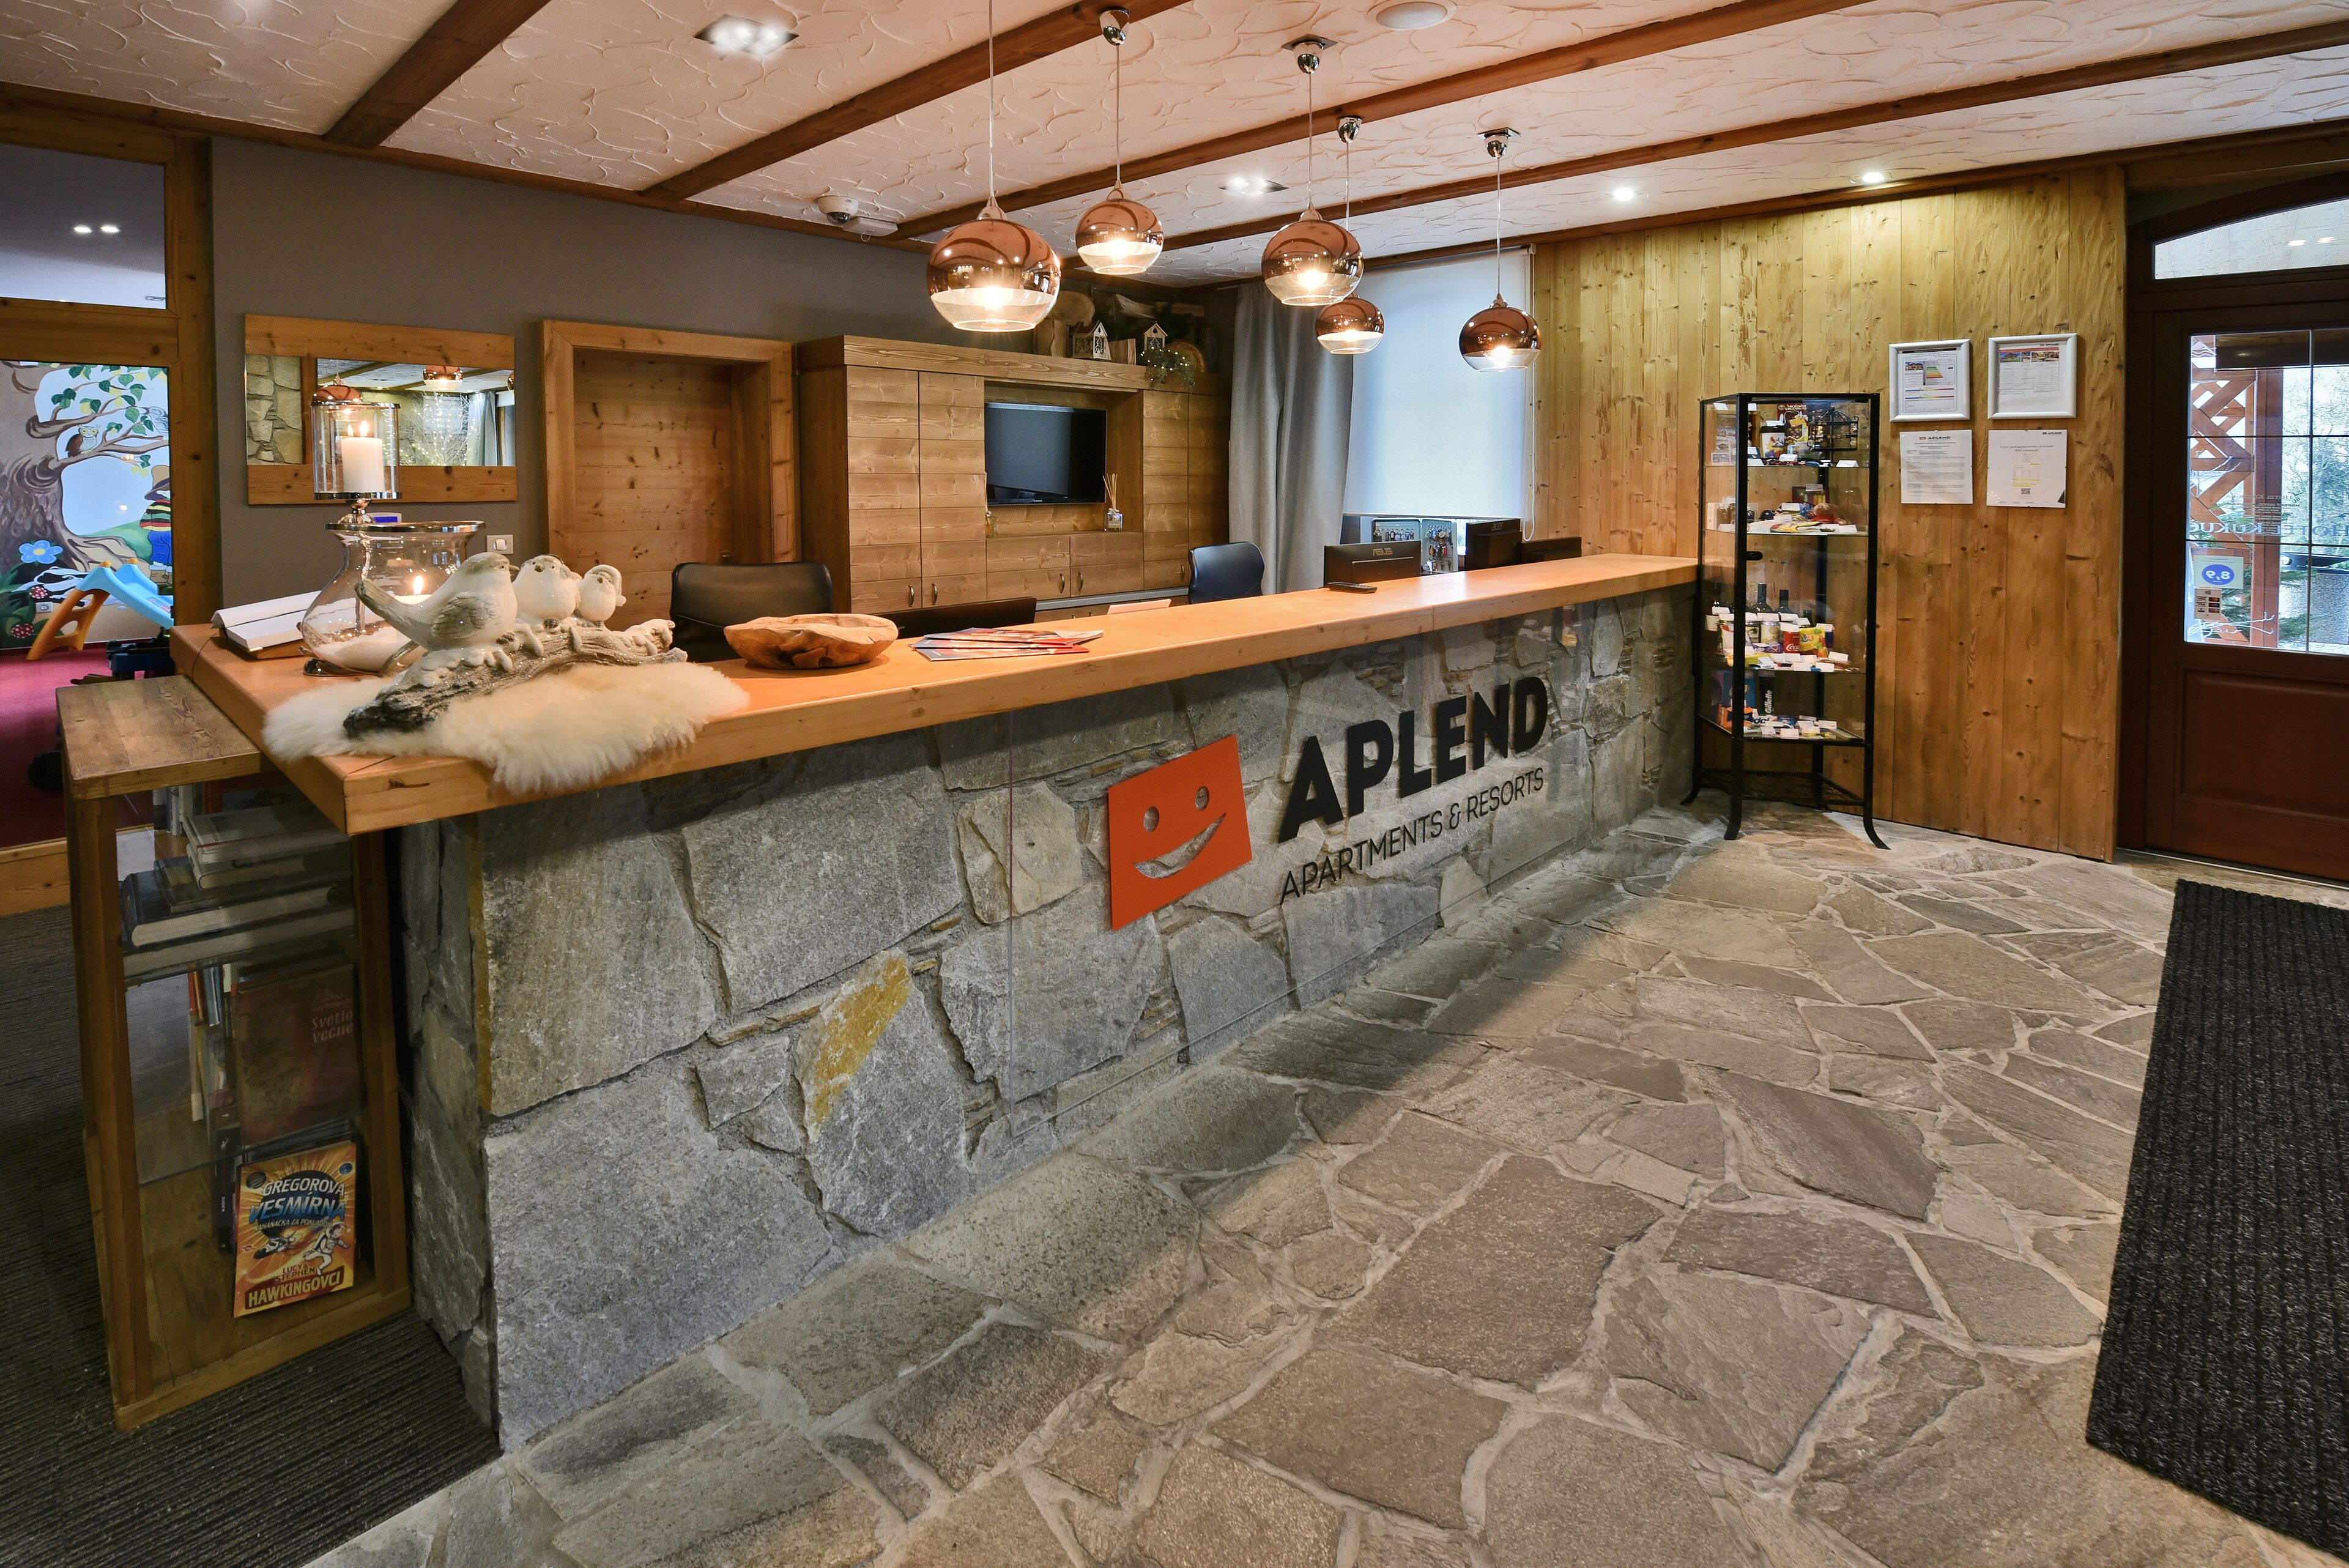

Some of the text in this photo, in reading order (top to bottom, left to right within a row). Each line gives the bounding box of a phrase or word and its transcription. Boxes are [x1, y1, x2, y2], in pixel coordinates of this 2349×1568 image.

[1491, 522, 1504, 532] acer
[1372, 548, 1393, 556] ASUS
[1764, 689, 1773, 714] Gillette
[1278, 676, 1548, 844] APLEND
[1280, 767, 1545, 905] APARTMENTS & RESORTS
[263, 1177, 345, 1197] GREGOROVA
[248, 1192, 346, 1224] VESMÍRNA
[275, 1266, 316, 1282] STEPHEN
[282, 1264, 302, 1274] LUCY
[248, 1271, 341, 1308] HAWKINGOVCI
